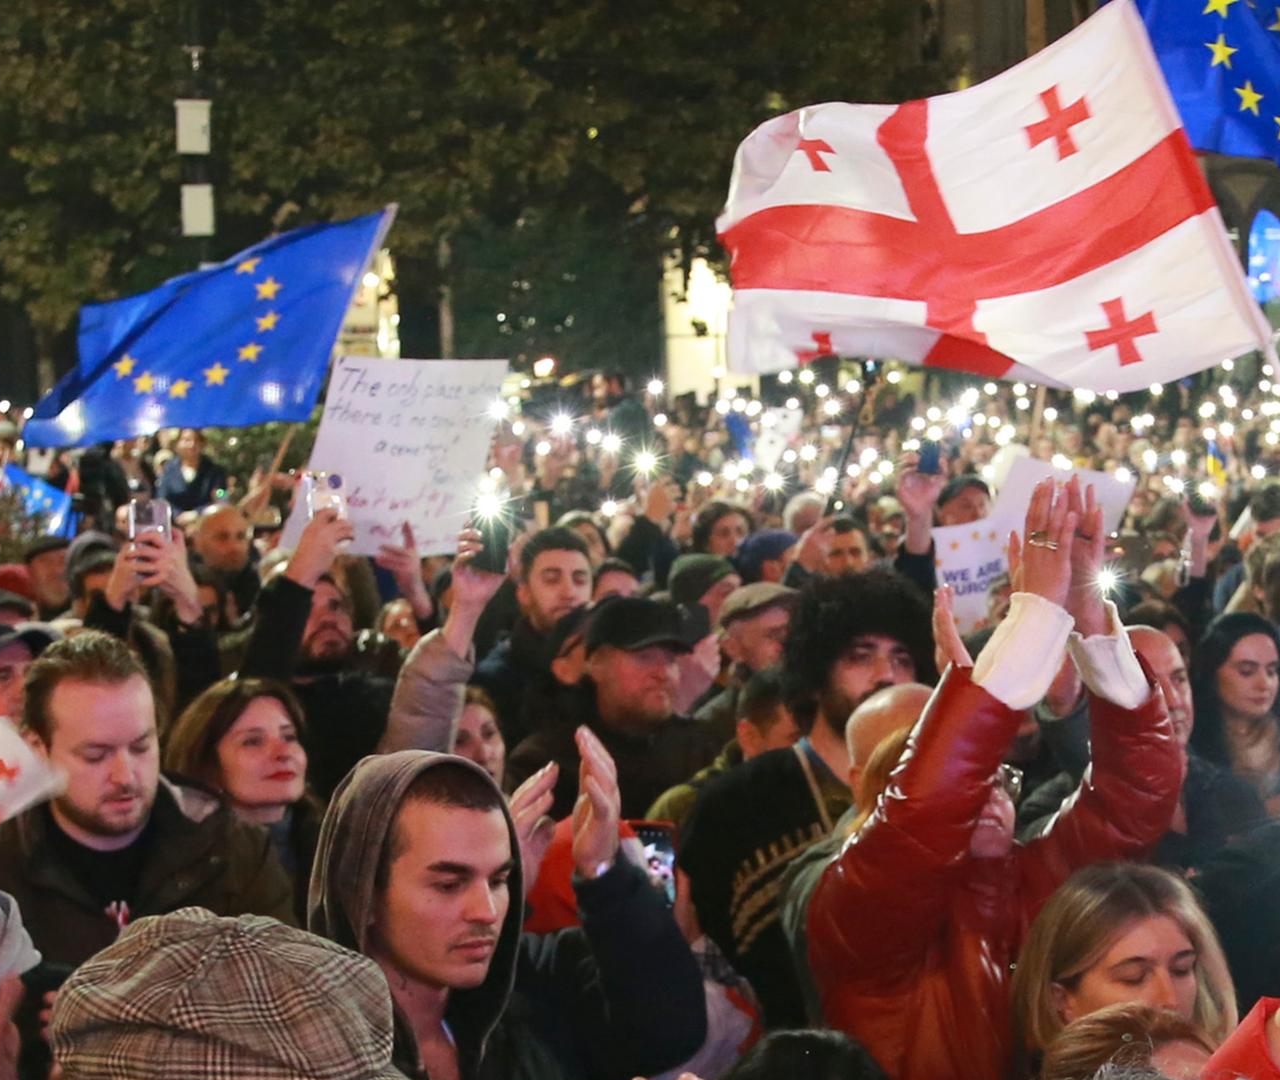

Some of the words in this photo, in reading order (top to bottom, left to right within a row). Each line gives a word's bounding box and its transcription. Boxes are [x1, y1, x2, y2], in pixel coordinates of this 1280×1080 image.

[943, 567, 970, 582] WE
[977, 558, 1002, 578] ARE
[953, 580, 989, 596] URO
